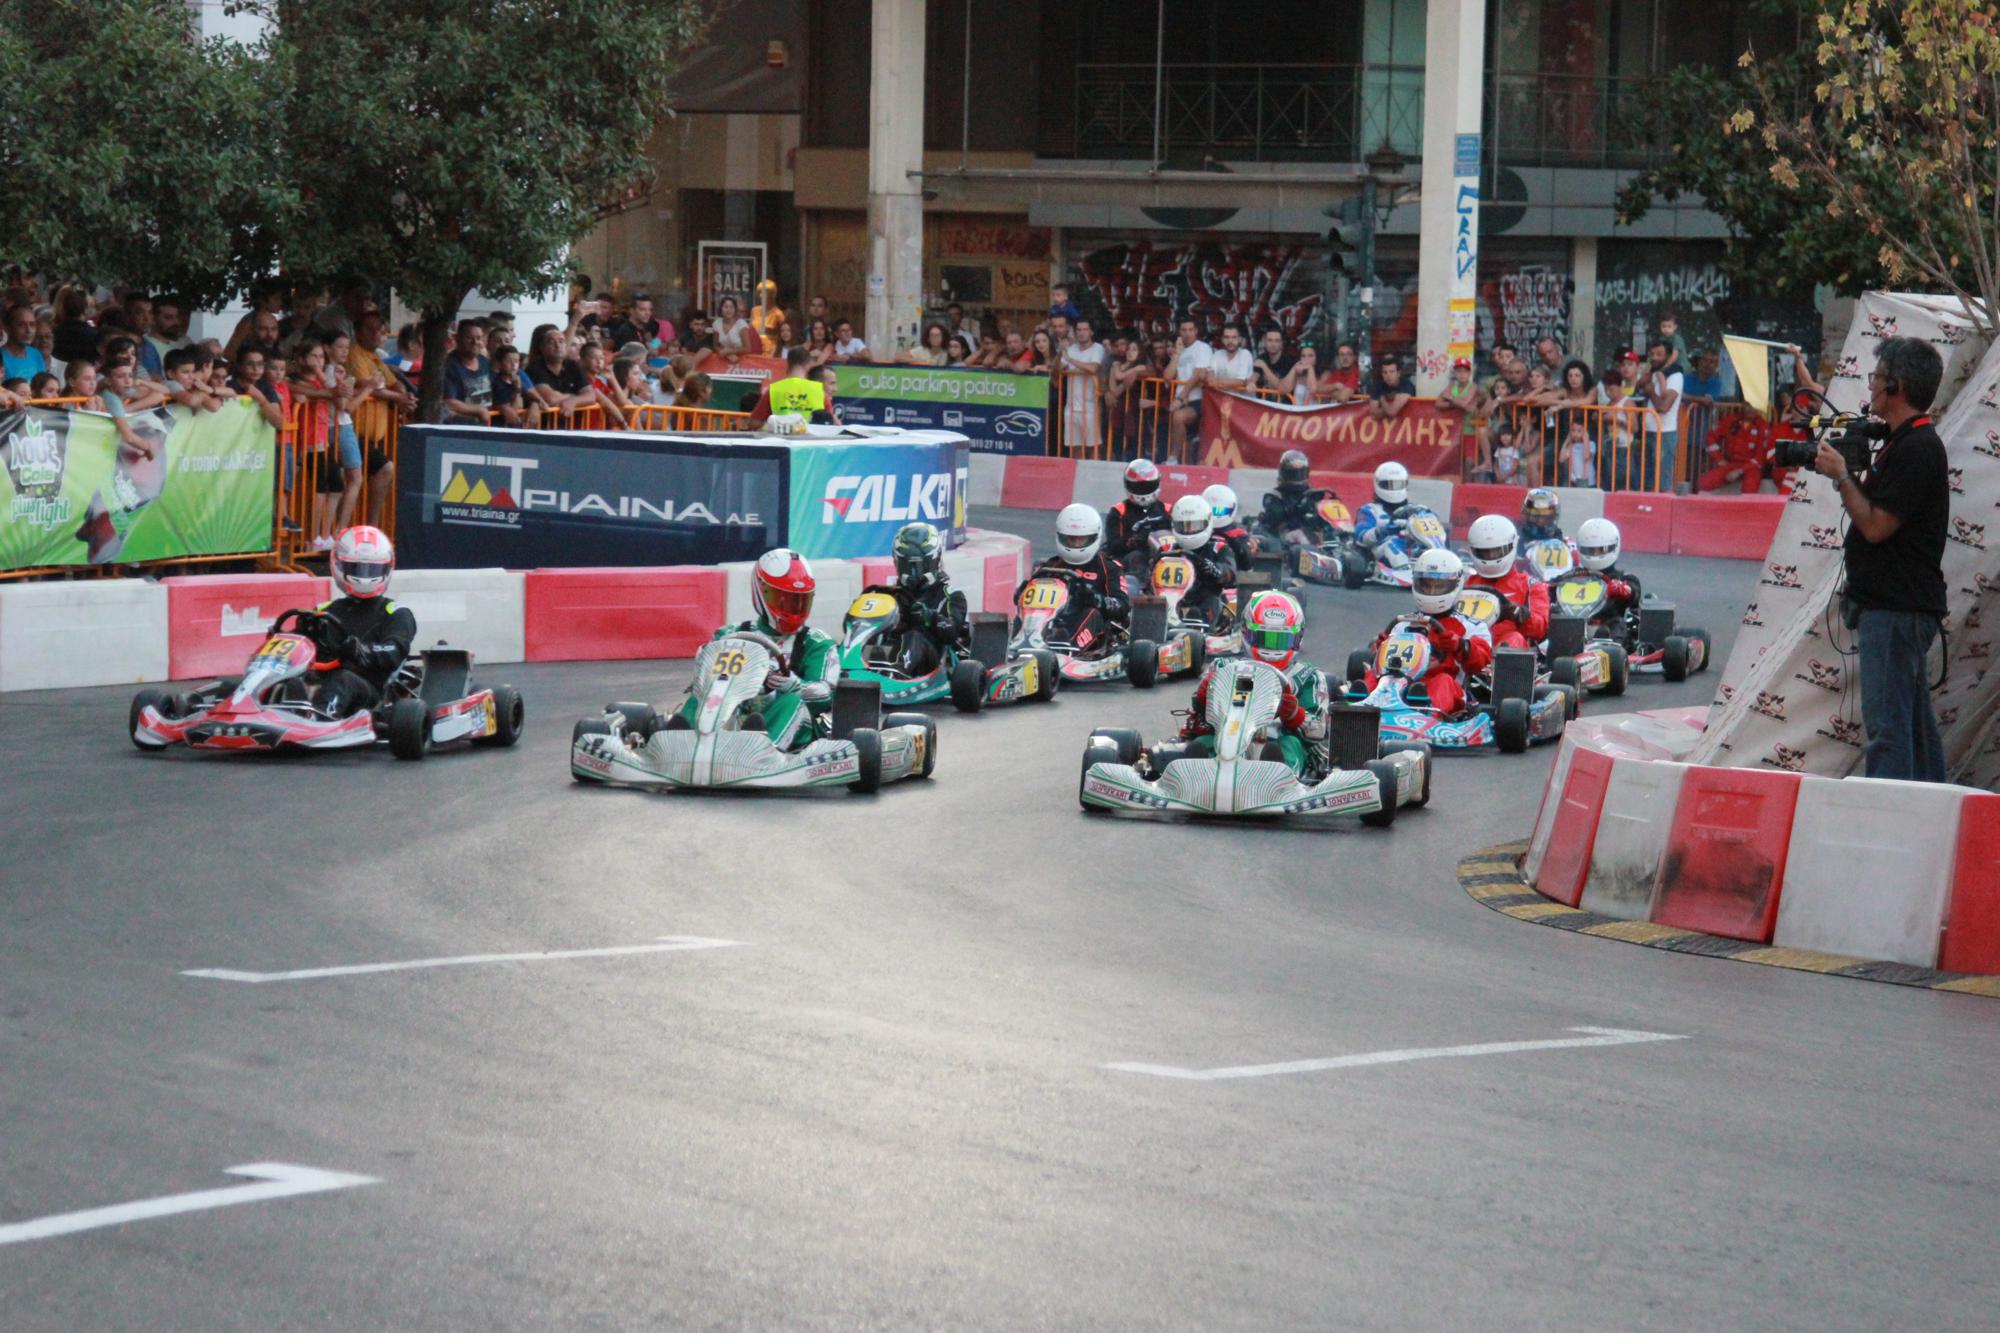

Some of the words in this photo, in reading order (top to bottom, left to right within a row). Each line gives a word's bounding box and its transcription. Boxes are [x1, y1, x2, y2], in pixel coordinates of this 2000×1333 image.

[714, 273, 750, 292] SALE
[859, 372, 897, 390] auto
[901, 372, 960, 398] parking
[964, 376, 1017, 399] patras
[441, 505, 520, 524] www.triaina.gr
[1023, 588, 1057, 606] 911
[1575, 588, 1586, 601] 4
[861, 599, 875, 612] 5
[267, 639, 297, 656] 19
[1386, 644, 1415, 663] 24
[713, 652, 745, 677] 56
